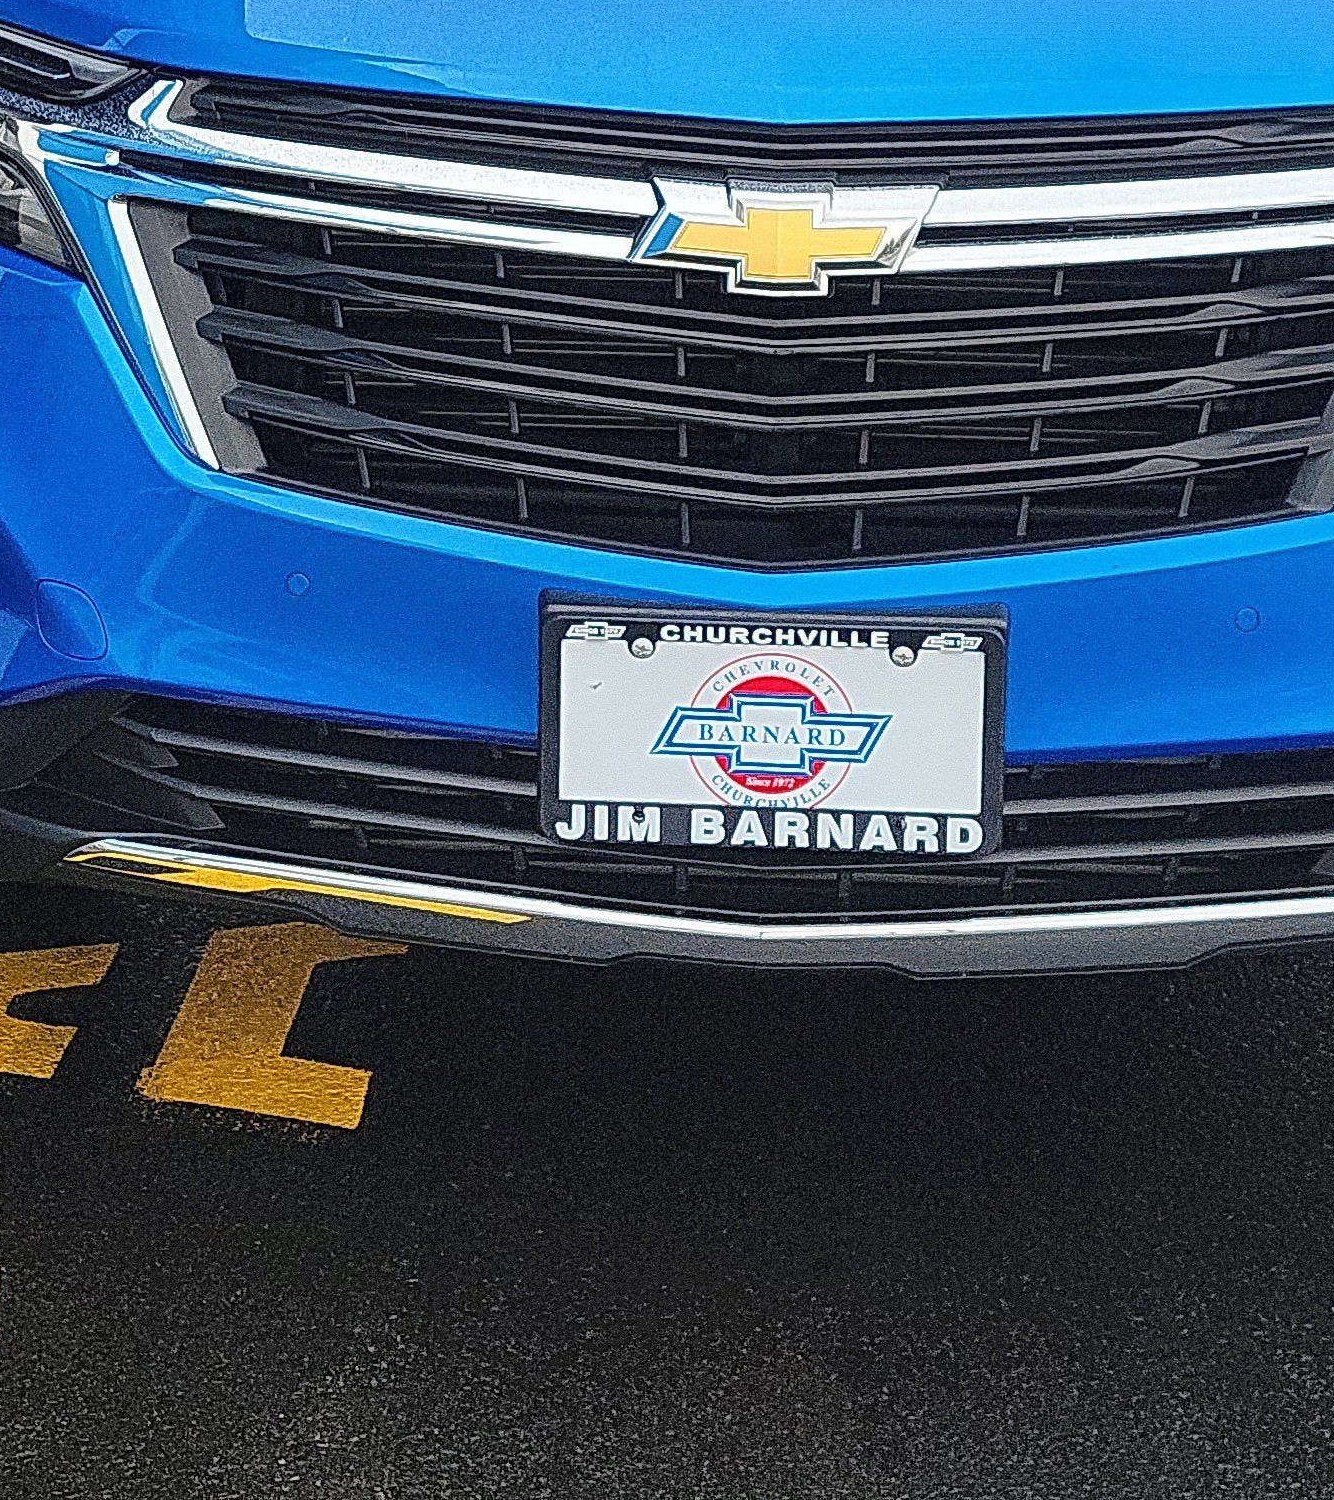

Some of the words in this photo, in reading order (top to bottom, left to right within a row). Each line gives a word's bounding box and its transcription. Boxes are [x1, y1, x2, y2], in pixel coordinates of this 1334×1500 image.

[659, 623, 890, 649] CHURCHVILLE
[712, 659, 836, 698] CHEVROLET
[698, 723, 846, 747] BARNARD
[711, 773, 831, 808] CHURCHVILLE
[554, 804, 662, 843] JIM
[689, 807, 985, 854] BARNARD
